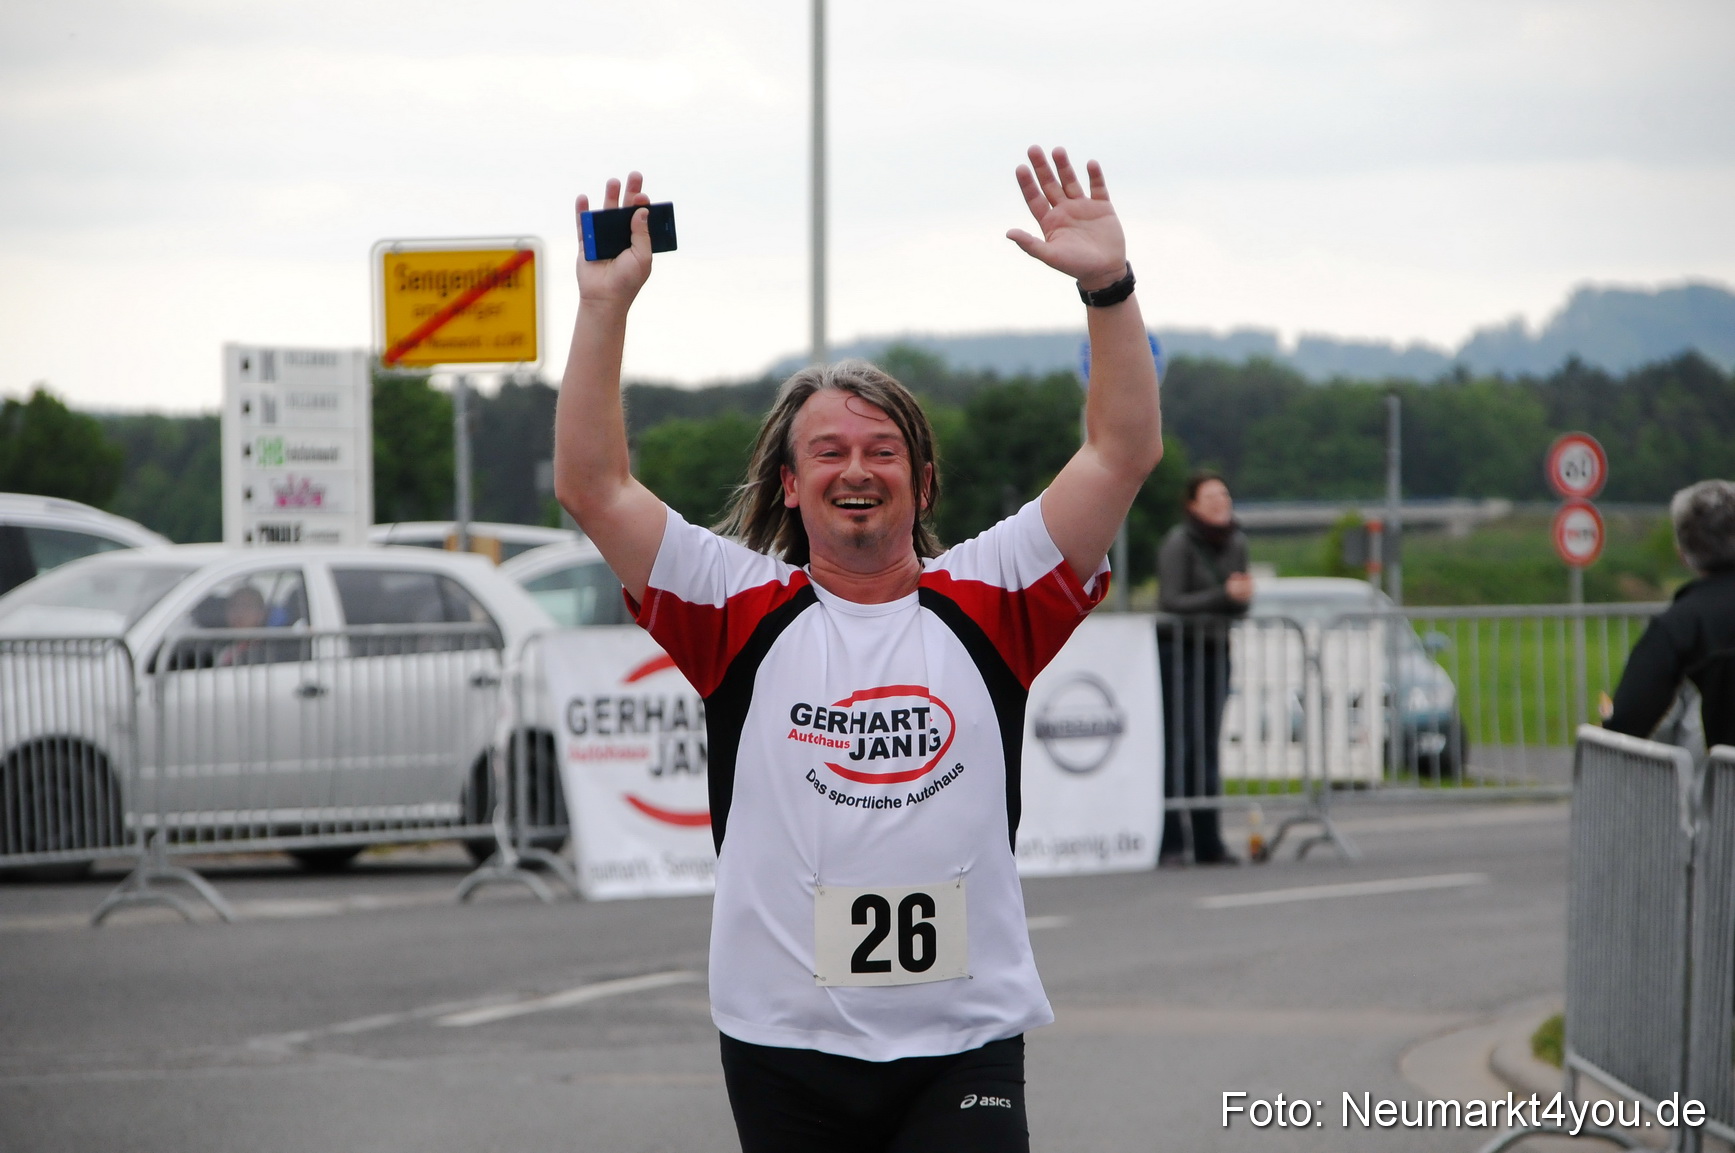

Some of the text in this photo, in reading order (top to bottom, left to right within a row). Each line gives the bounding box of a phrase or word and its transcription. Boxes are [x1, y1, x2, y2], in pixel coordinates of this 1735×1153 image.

[790, 702, 930, 735] GERHART
[805, 762, 965, 810] Das sportliche Autohaus
[850, 892, 937, 974] 26
[979, 1095, 1012, 1108] asics
